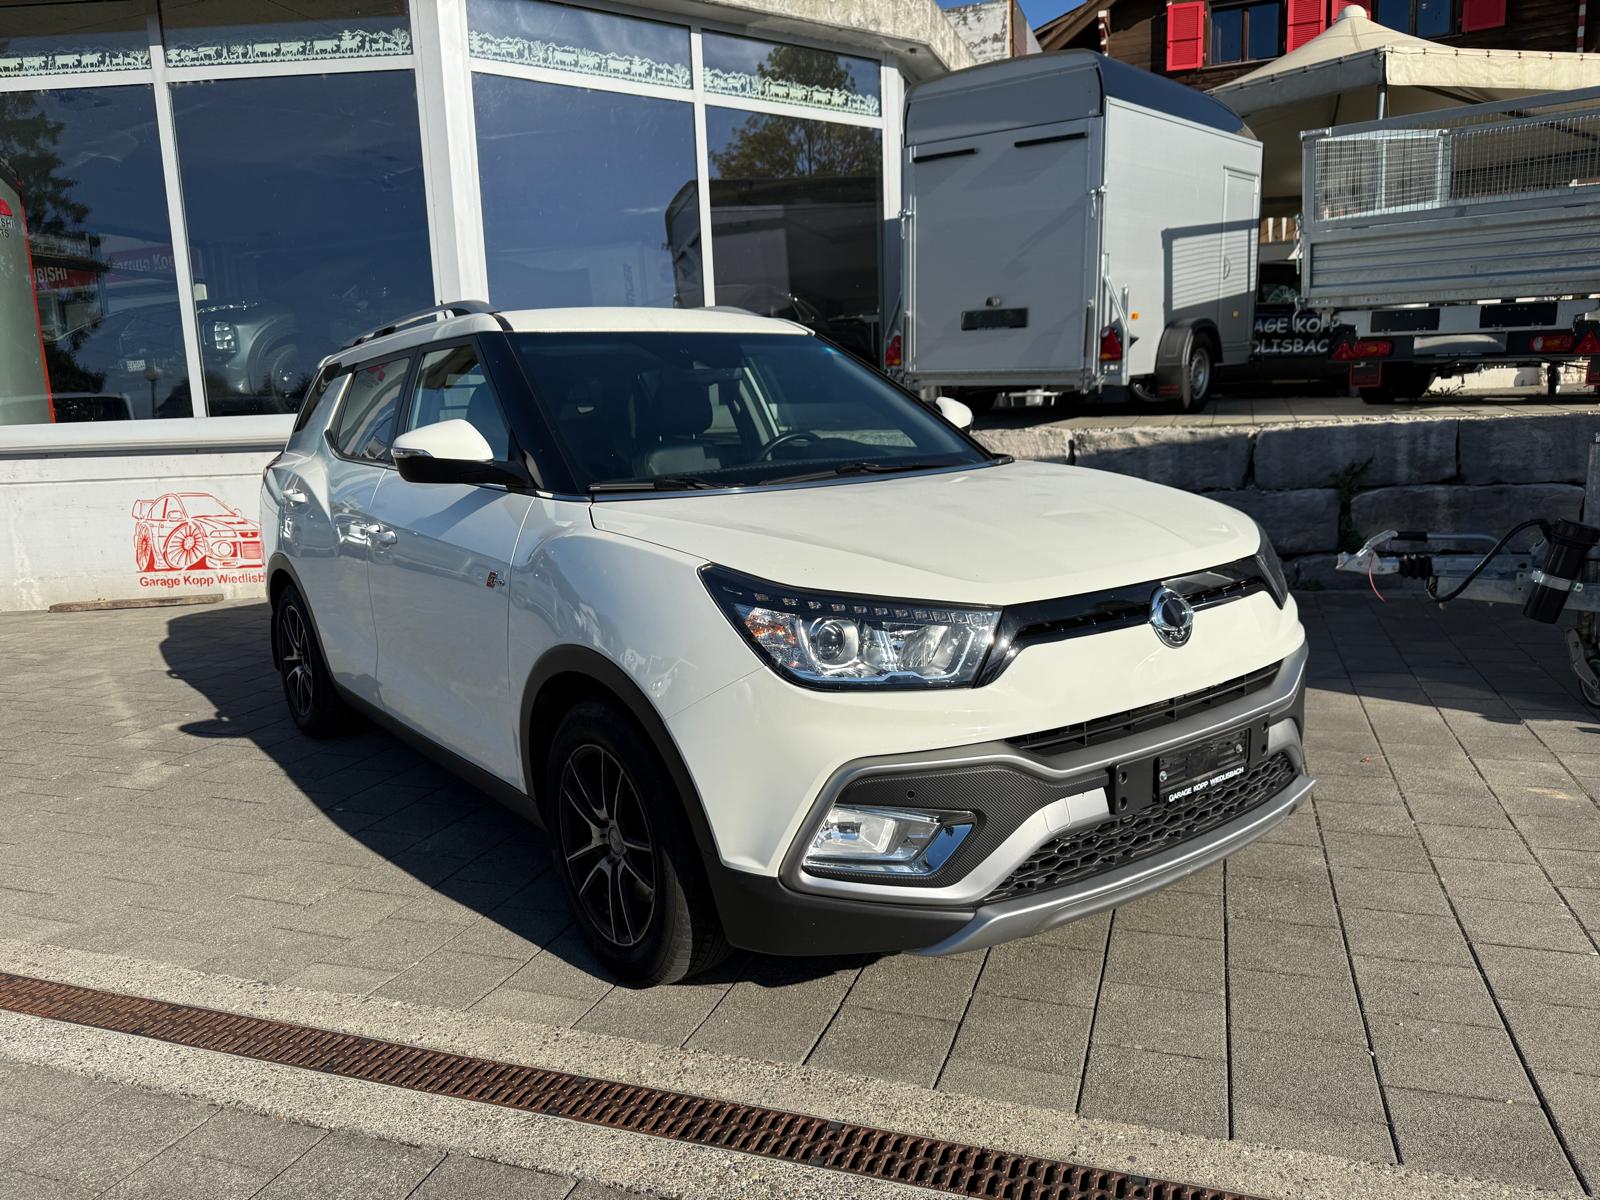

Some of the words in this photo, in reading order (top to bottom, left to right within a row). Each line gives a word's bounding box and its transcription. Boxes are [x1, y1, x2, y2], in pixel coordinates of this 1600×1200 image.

[139, 575, 181, 589] Garage
[183, 575, 215, 588] Kopp
[1168, 786, 1193, 803] GARAGE
[1193, 780, 1209, 793] KOPP
